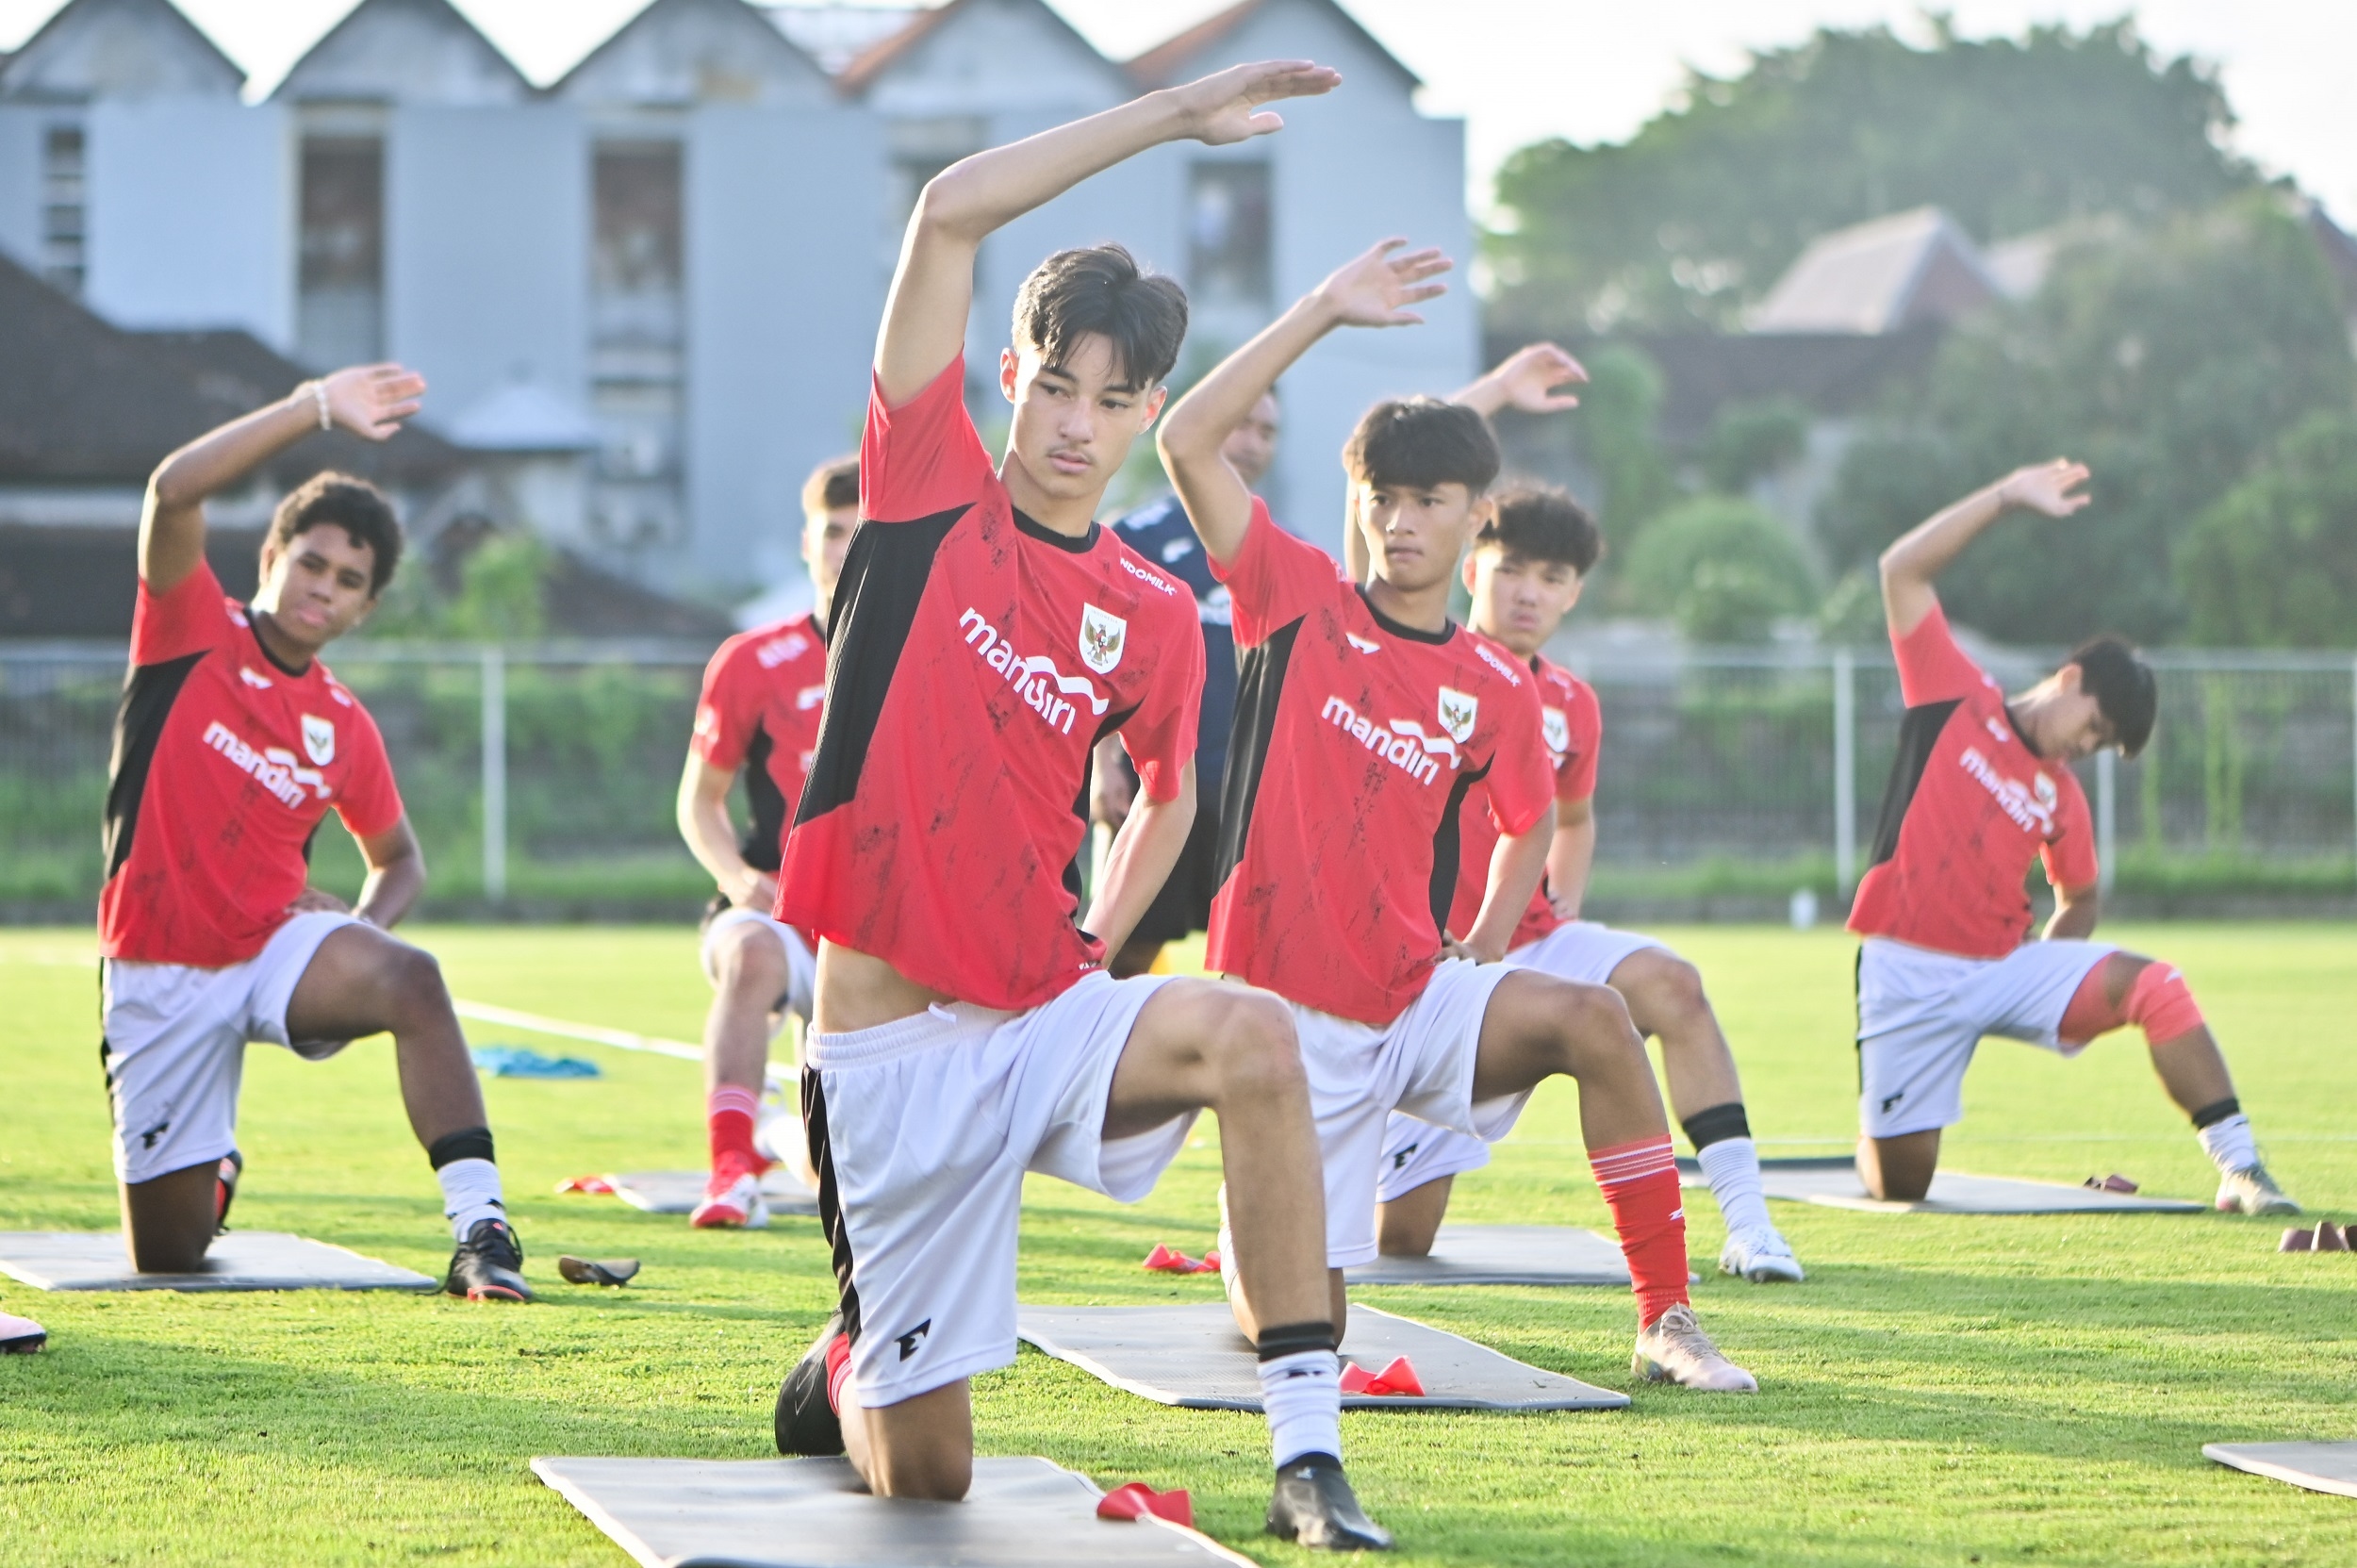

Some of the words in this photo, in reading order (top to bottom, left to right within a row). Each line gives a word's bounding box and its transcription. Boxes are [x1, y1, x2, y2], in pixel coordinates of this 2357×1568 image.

[1119, 557, 1177, 596] NDOMILK
[1474, 643, 1522, 688] INDOMILK
[202, 719, 307, 811] mandiri
[1321, 695, 1440, 786] mandiri
